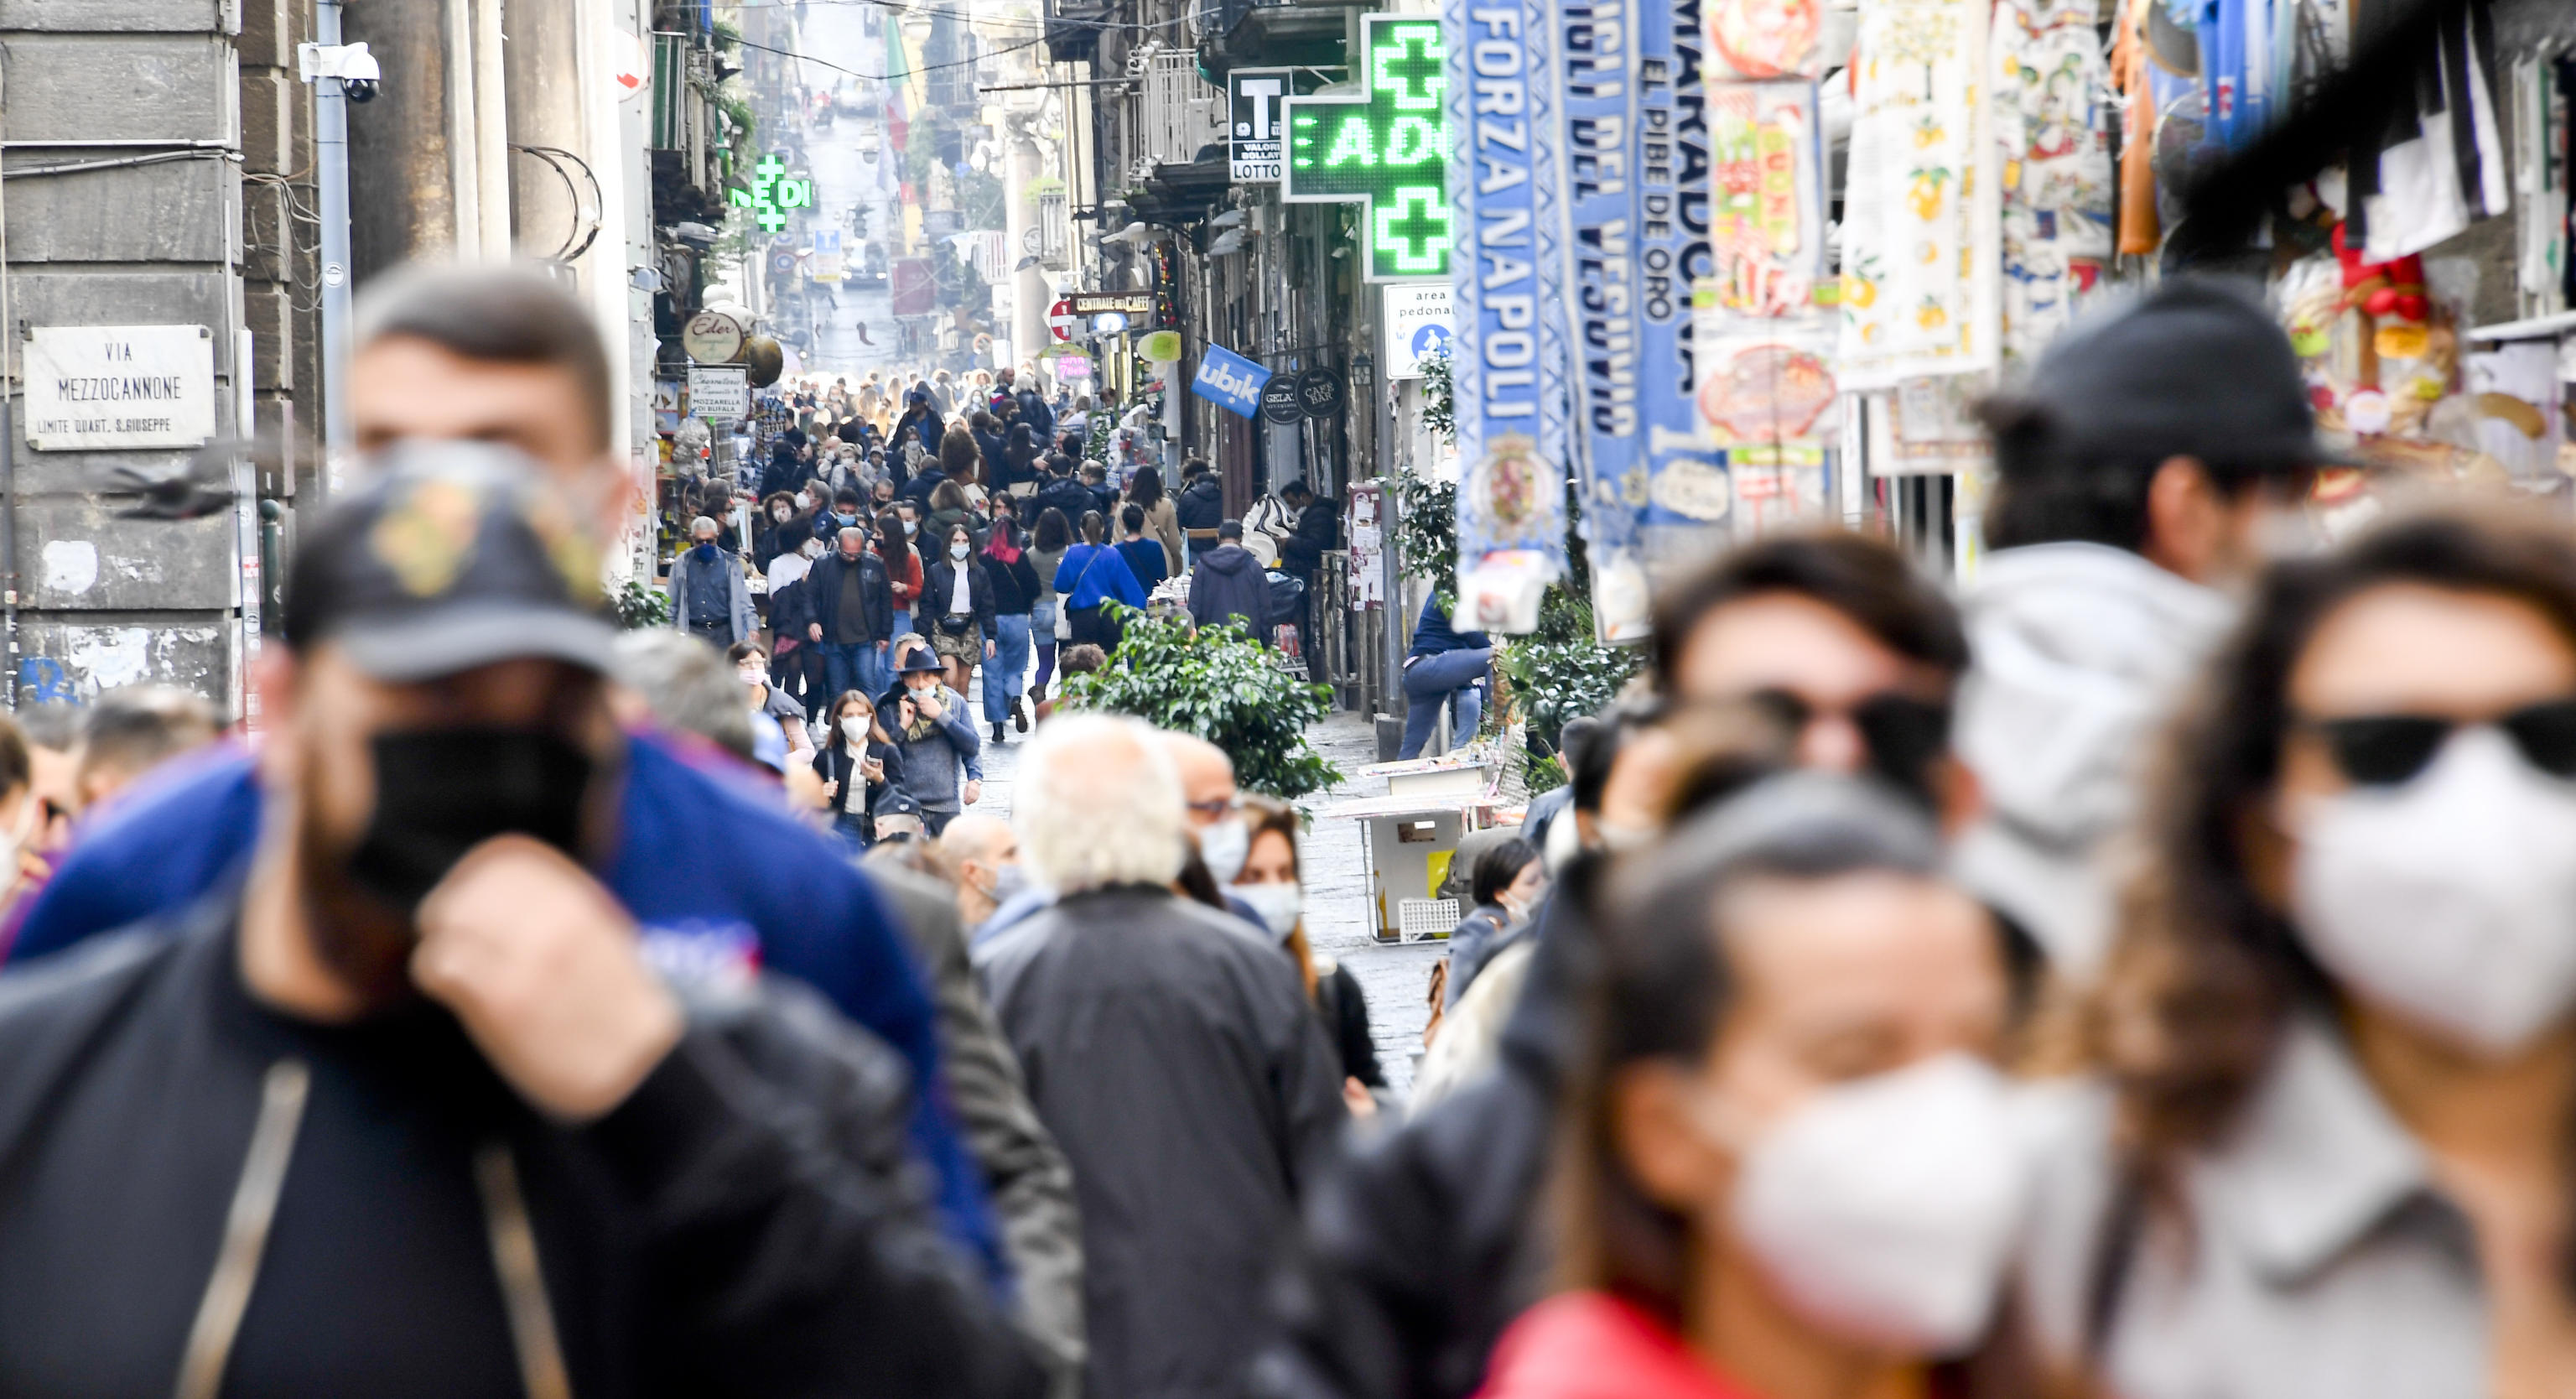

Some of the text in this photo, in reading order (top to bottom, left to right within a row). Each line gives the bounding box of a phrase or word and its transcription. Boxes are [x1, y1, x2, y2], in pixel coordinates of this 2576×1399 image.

[1240, 79, 1281, 139] T
[1242, 152, 1280, 160] BOLLAT
[1243, 143, 1280, 152] VALORI
[1571, 116, 1625, 202] DEL
[1234, 164, 1281, 179] LOTTO
[1641, 60, 1671, 320] EL PIBE DE ORO
[1471, 7, 1536, 418] FORZA NAPOLI
[1077, 297, 1115, 312] CENTRALE
[1416, 292, 1446, 301] area
[1400, 304, 1456, 319] pedonal
[1578, 219, 1635, 438] VESUVIO
[105, 342, 132, 361] VIA
[59, 377, 181, 401] MEZZOCANNONE
[1199, 362, 1260, 405] ubik
[38, 420, 69, 434] LIMITE
[75, 419, 111, 433] QUART.
